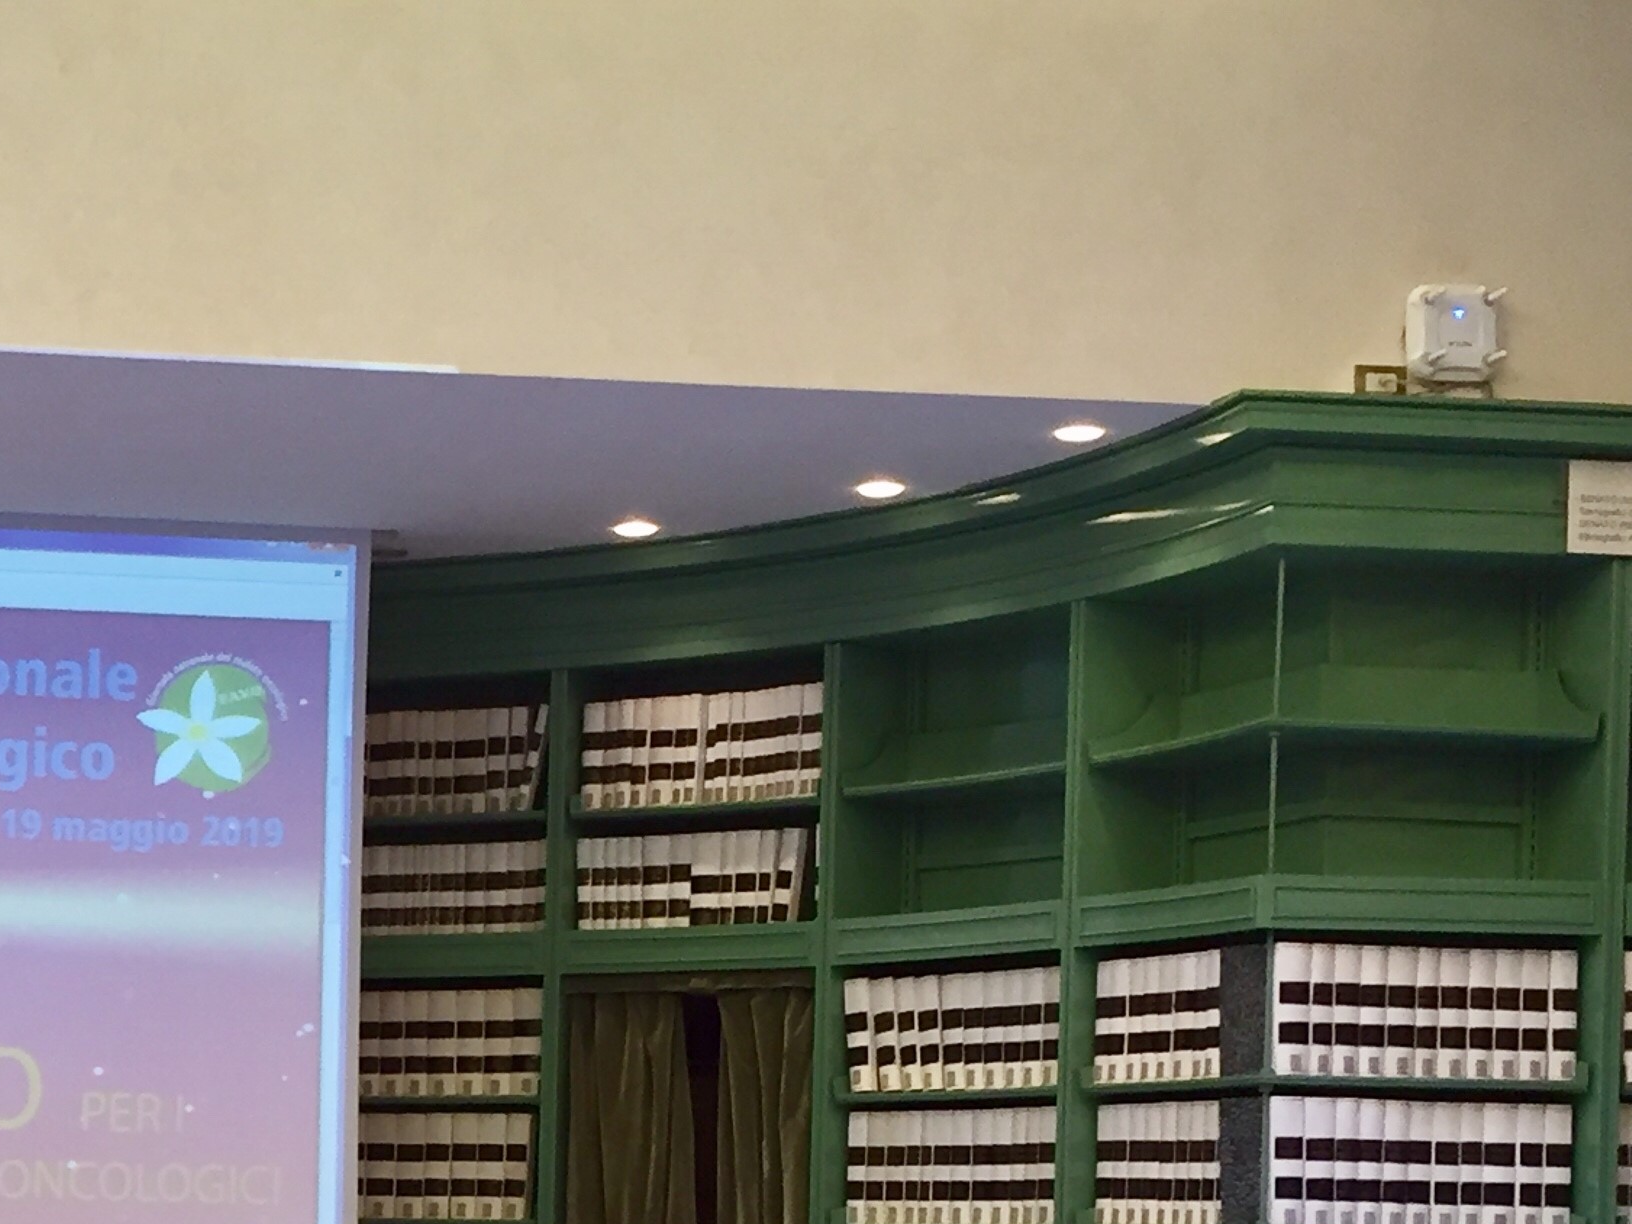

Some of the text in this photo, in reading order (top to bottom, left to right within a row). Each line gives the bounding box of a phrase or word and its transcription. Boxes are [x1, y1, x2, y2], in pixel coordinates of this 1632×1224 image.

[51, 811, 188, 852] maggio
[199, 815, 285, 848] 2019
[79, 1091, 164, 1134] PER
